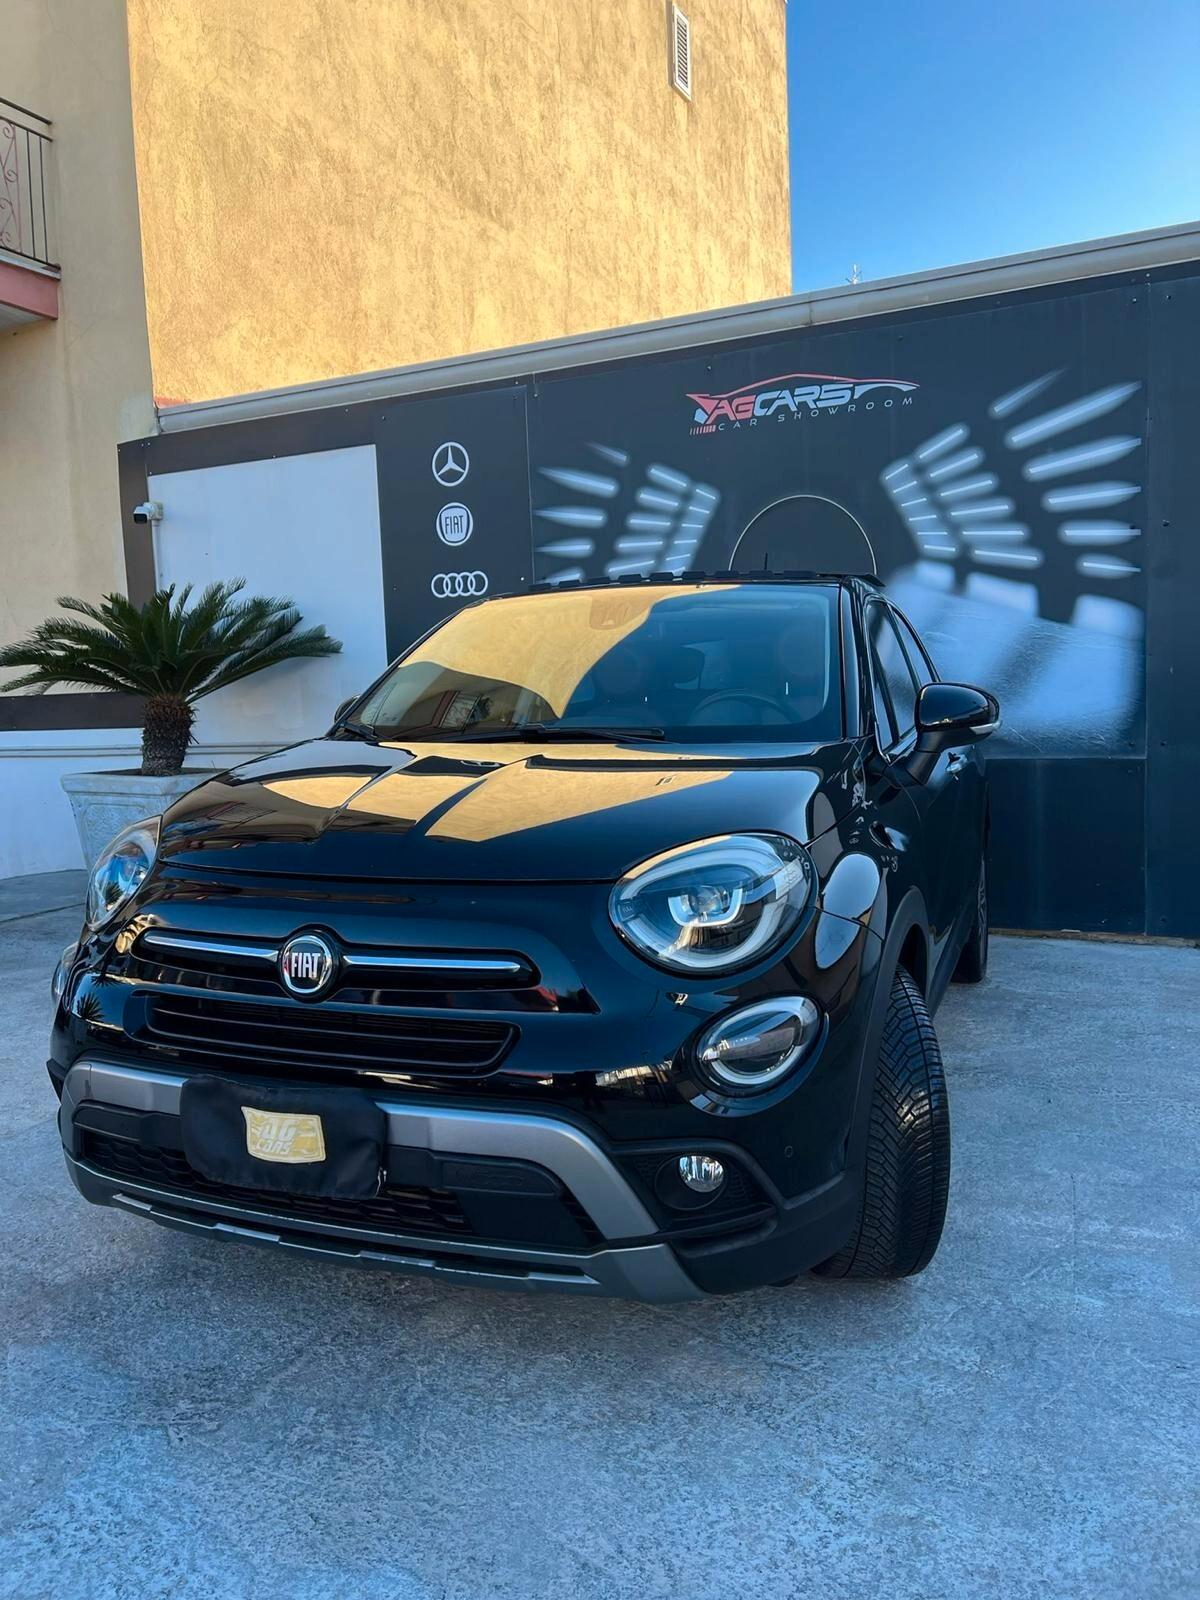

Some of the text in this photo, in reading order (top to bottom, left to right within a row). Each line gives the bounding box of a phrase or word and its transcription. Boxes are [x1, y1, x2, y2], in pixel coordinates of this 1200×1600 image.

[717, 397, 913, 432] CAR SHOWROOM
[445, 515, 463, 534] FIAT
[291, 952, 321, 978] FIAT
